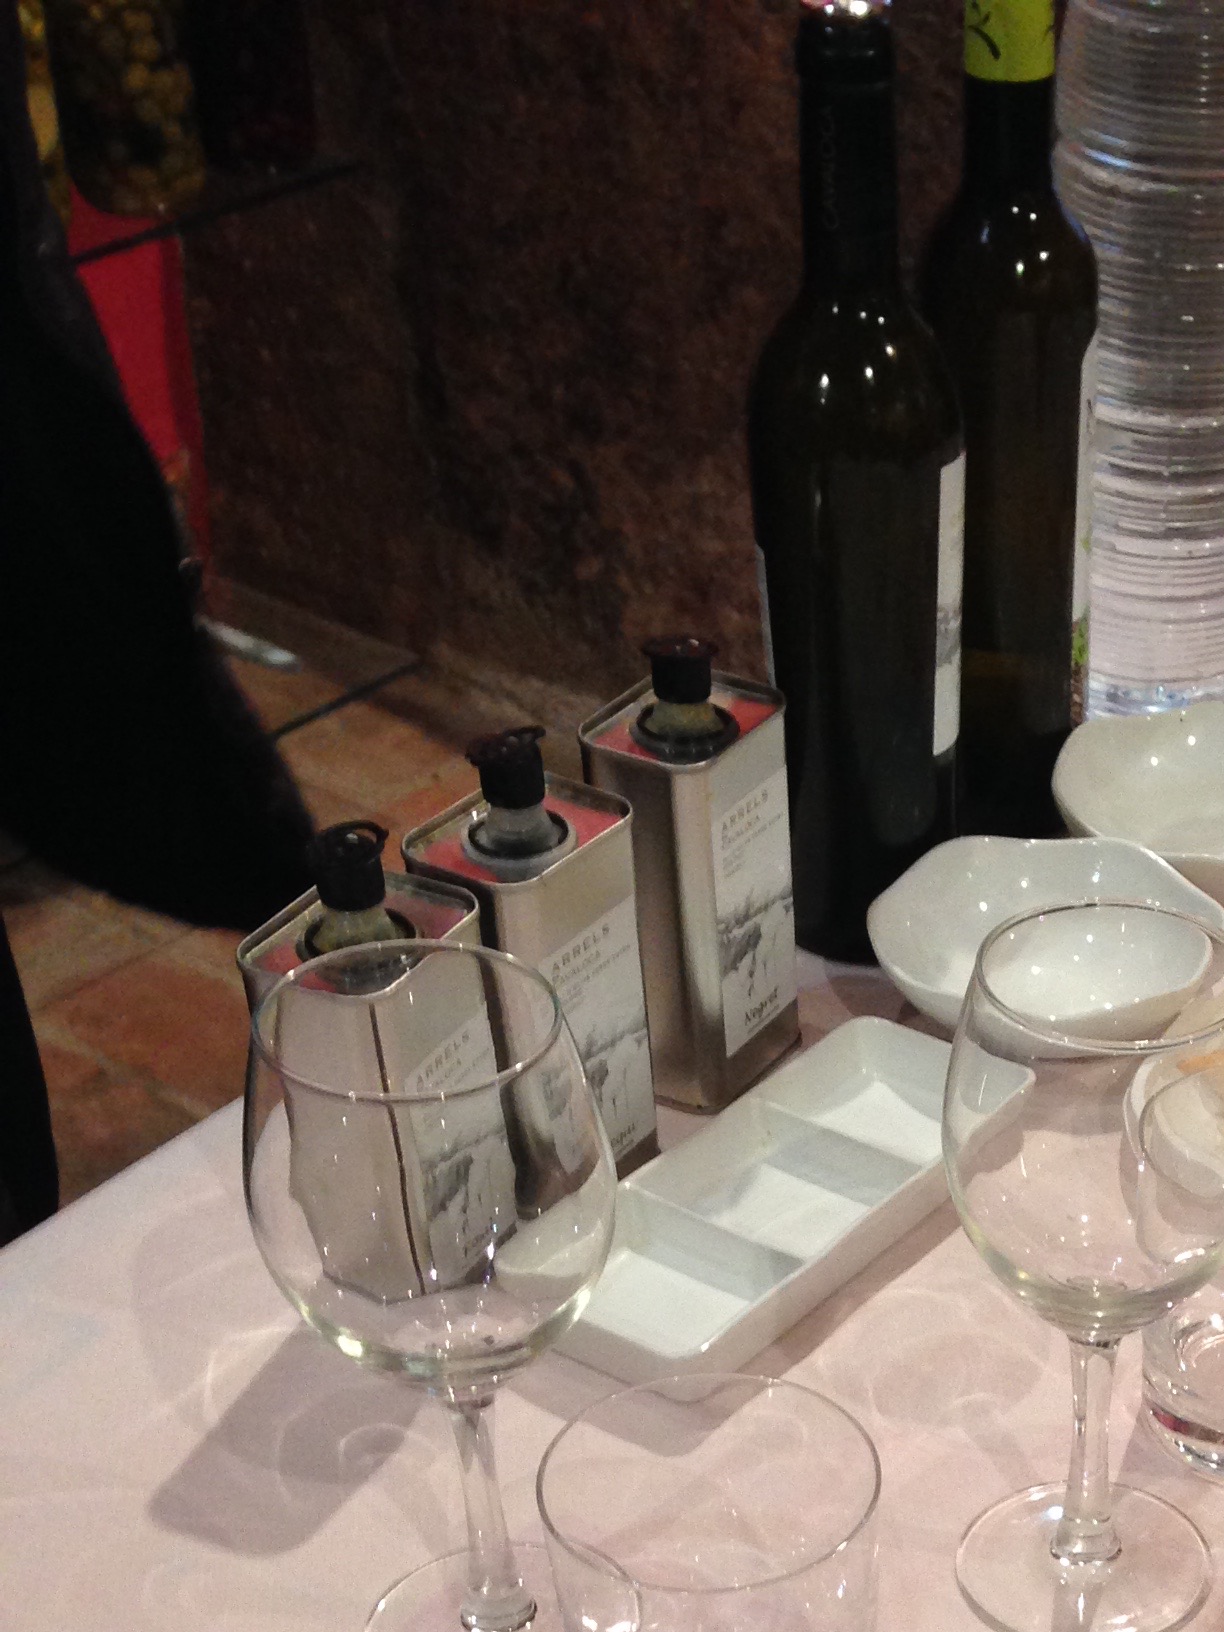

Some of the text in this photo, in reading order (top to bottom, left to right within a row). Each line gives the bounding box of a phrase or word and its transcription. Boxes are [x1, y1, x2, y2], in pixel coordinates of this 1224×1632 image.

[721, 788, 768, 834] ARRELS
[552, 923, 610, 973] ARRELS
[416, 1030, 470, 1090] ARRELS
